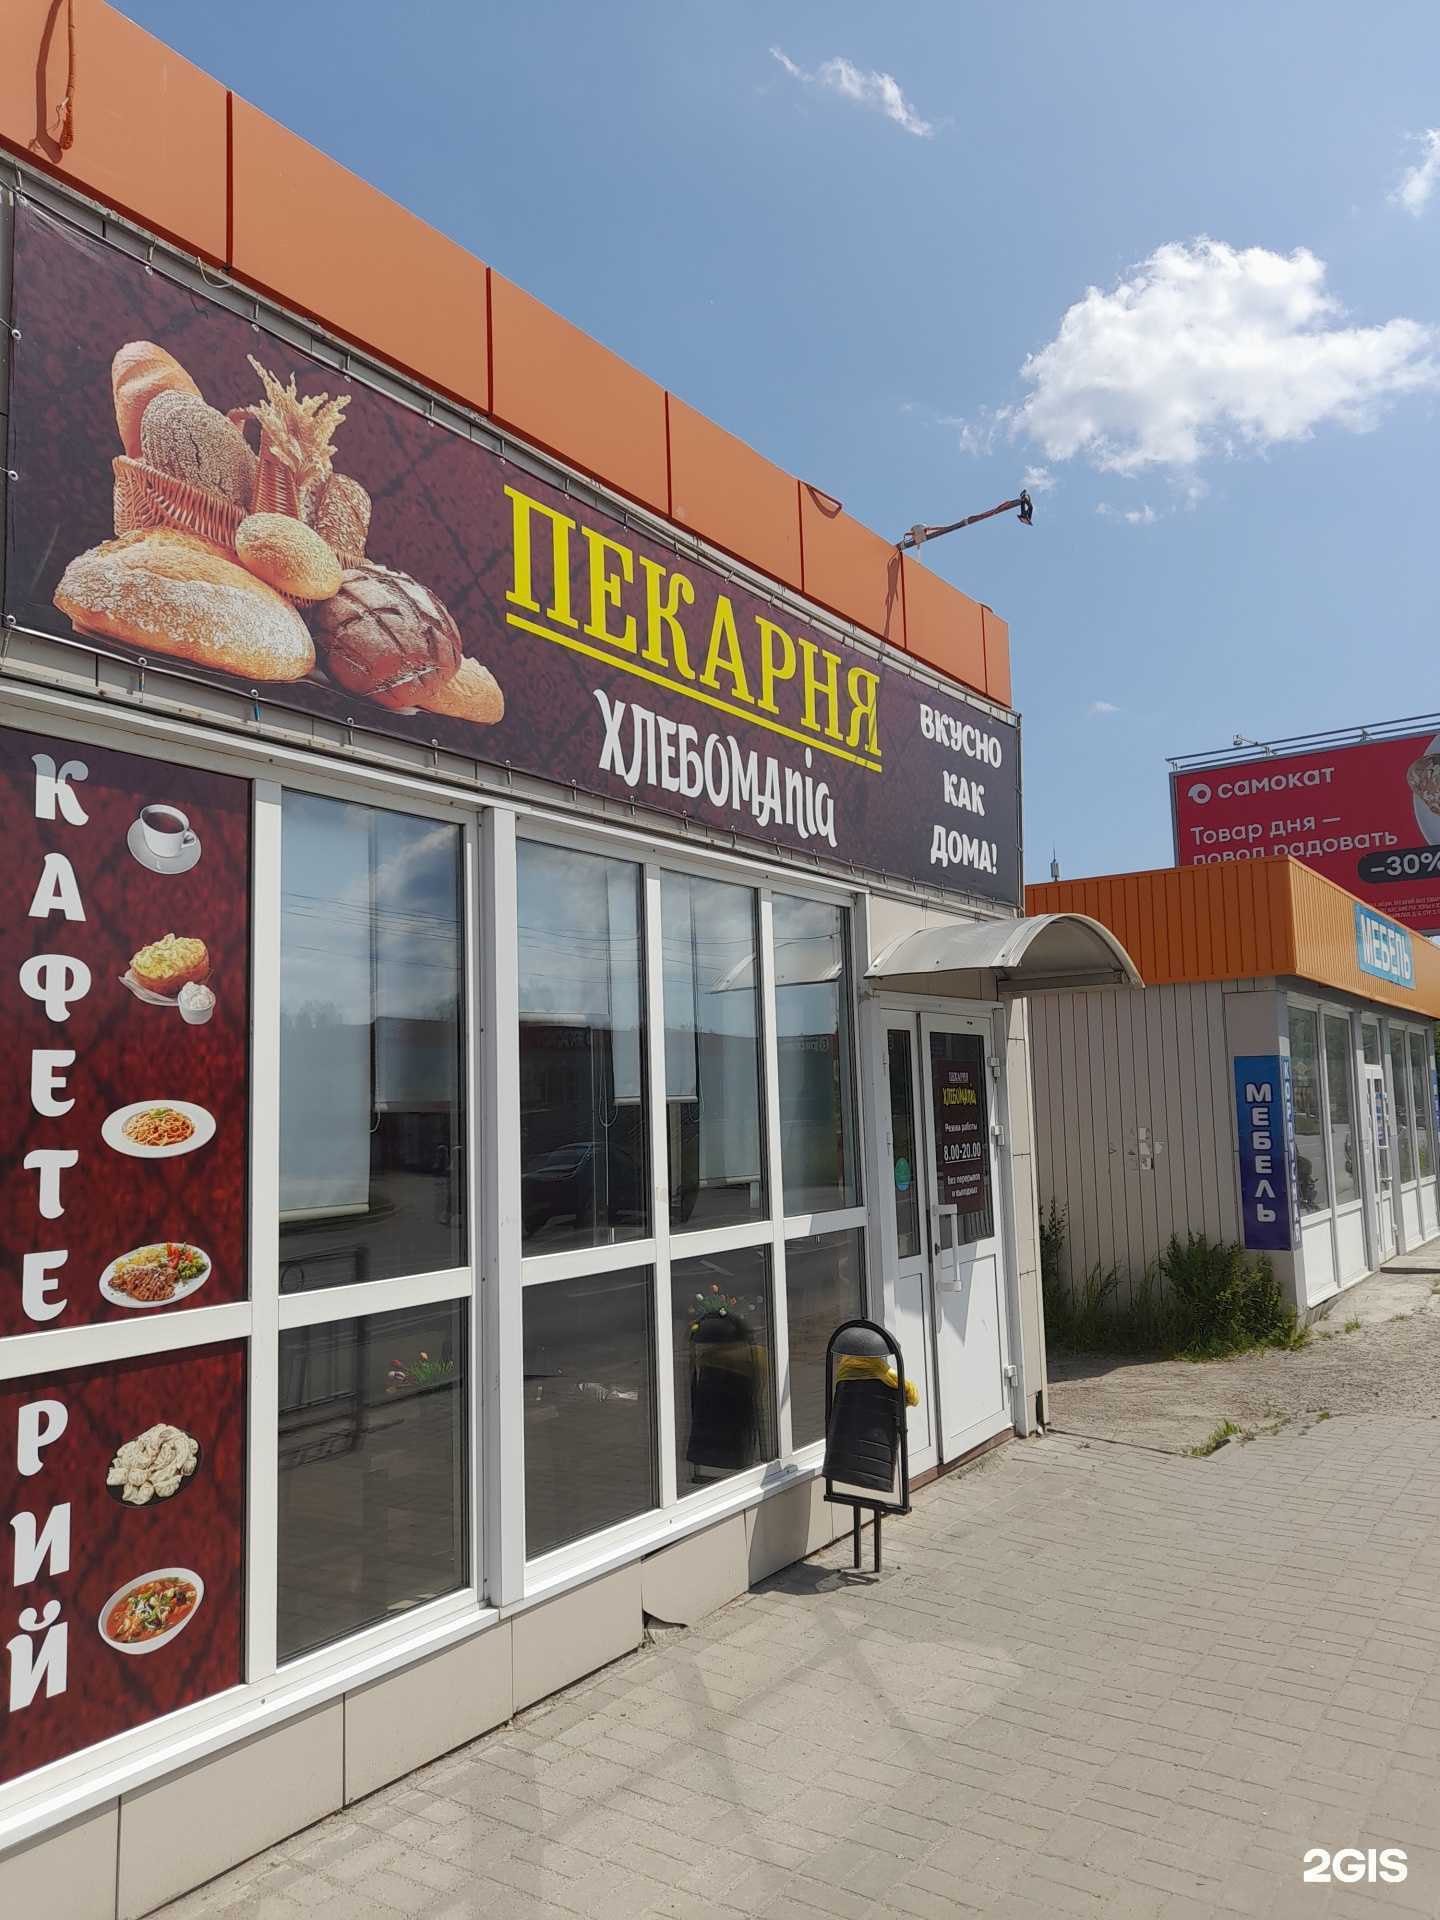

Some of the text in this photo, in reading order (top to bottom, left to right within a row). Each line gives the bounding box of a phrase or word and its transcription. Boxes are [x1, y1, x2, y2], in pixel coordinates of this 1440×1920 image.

[503, 485, 882, 757] ПЕКАРНЯ
[920, 704, 1002, 768] ВКУСНО
[942, 770, 985, 816] КАК
[1217, 767, 1335, 799] самокат
[930, 825, 997, 875] ДОМА!
[1190, 823, 1263, 846] Товар
[1269, 816, 1316, 838] дня
[1360, 914, 1411, 979] МЕБЕЛЬ
[943, 1142, 981, 1161] 8.00-20.00
[1245, 1083, 1277, 1223] МЕБЕЛЬ
